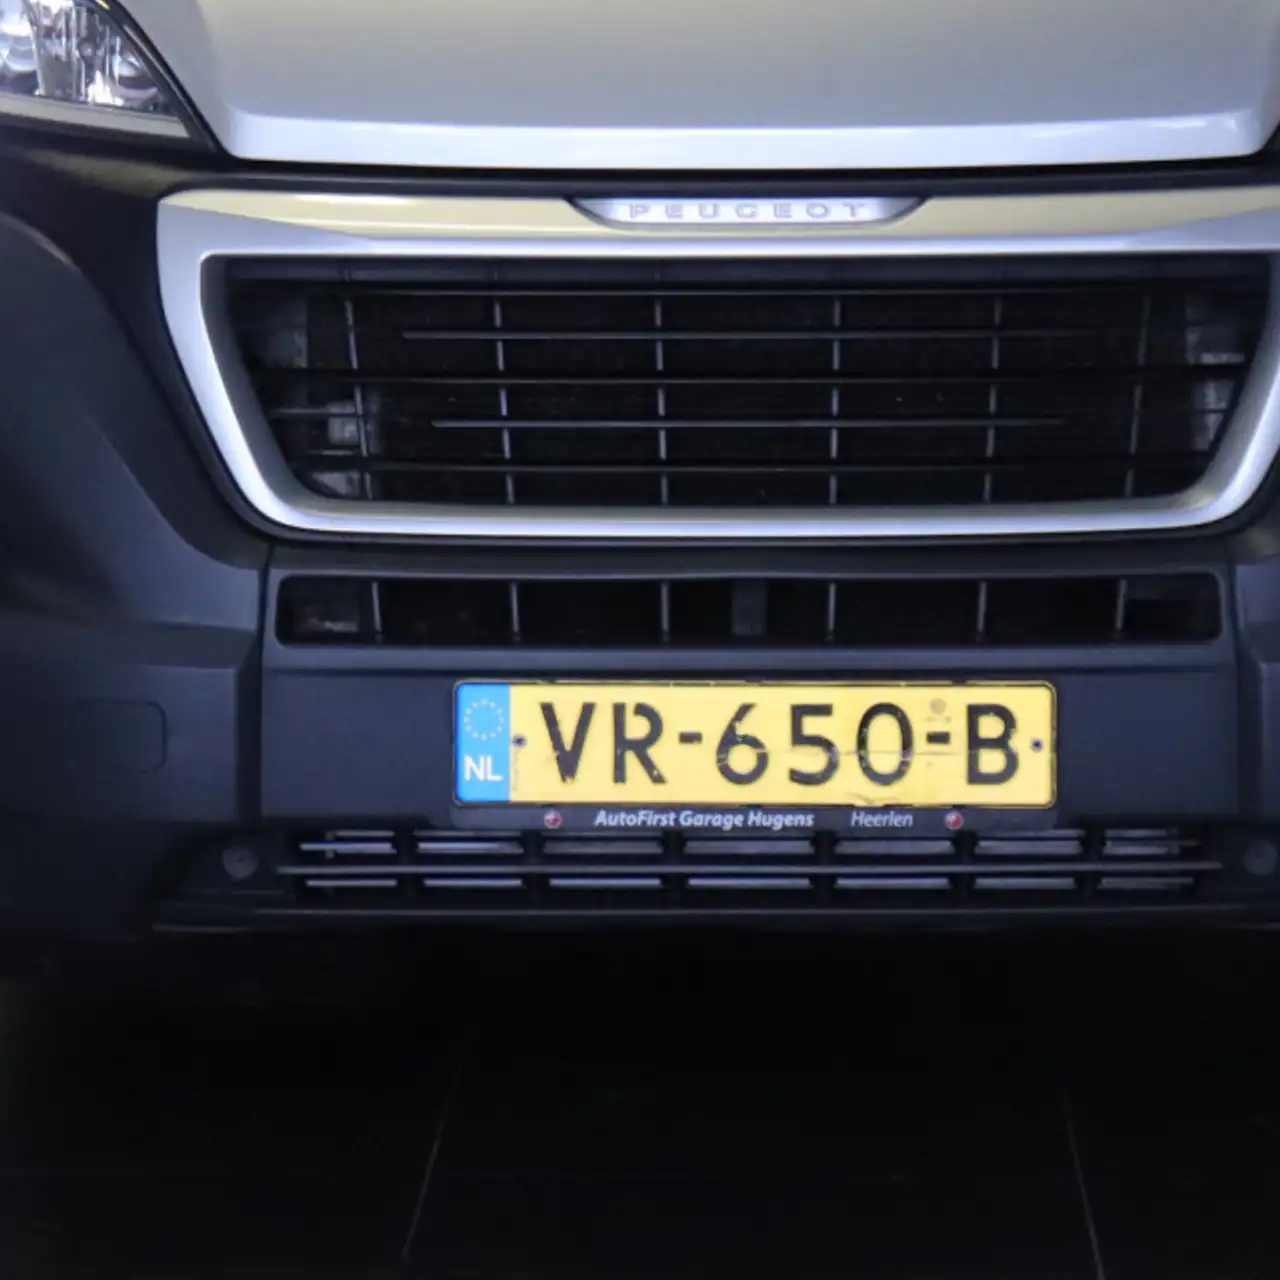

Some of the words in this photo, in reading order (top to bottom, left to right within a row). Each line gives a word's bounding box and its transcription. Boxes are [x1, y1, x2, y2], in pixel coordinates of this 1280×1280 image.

[628, 202, 866, 219] PEUGEOT
[539, 701, 1020, 787] VR-650-B
[463, 754, 504, 782] NL
[595, 809, 677, 827] AutoFirst
[679, 809, 744, 831] Garage
[747, 809, 815, 831] Hugens
[850, 809, 914, 827] Heerlen
